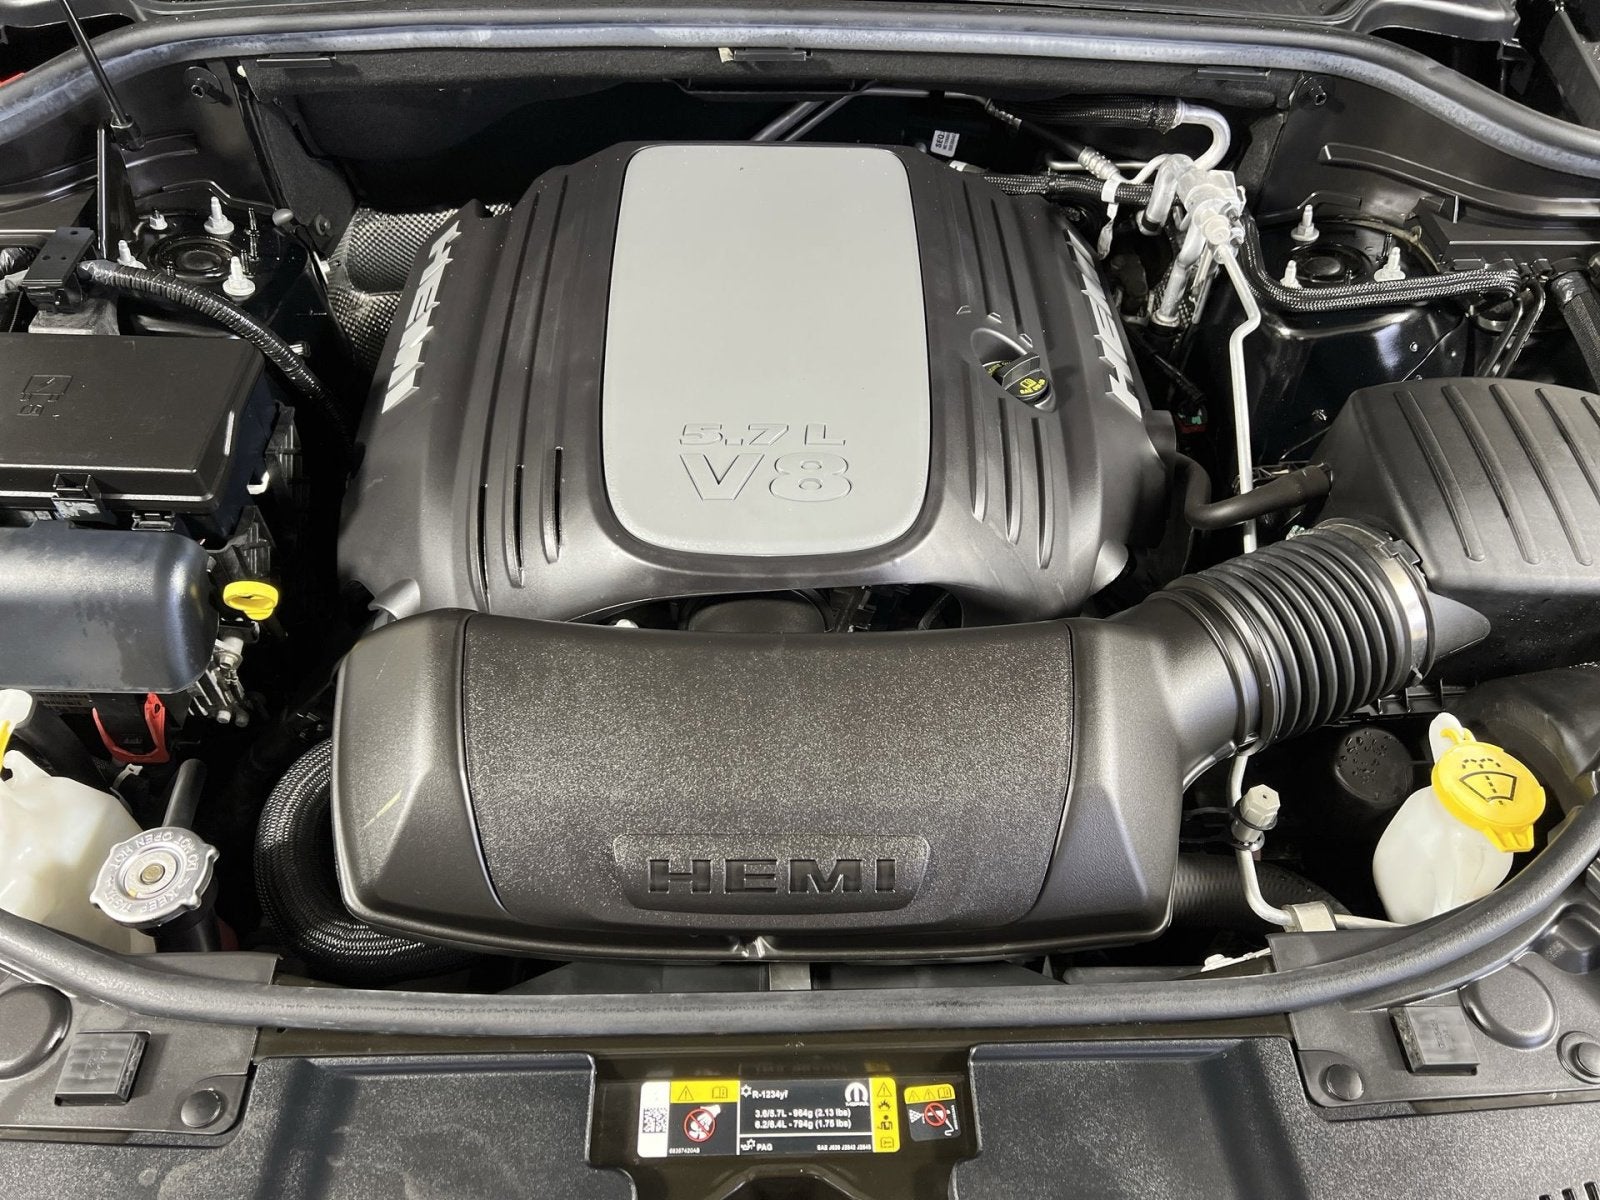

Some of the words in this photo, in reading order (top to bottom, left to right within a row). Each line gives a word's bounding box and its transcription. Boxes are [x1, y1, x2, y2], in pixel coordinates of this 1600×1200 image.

[381, 220, 462, 414] HEMI
[1066, 229, 1142, 419] HEMI
[679, 423, 790, 446] 5.7
[803, 423, 847, 446] L
[679, 452, 852, 503] V8
[135, 831, 174, 848] OPEN
[109, 845, 134, 871] HOT
[648, 858, 897, 894] HEMI
[140, 890, 179, 911] KEEP
[751, 1089, 789, 1101] R-1234yf
[814, 1108, 835, 1119] (2.13
[836, 1107, 852, 1118] lbs)
[836, 1118, 852, 1129] lbs)
[756, 1143, 774, 1151] PAG
